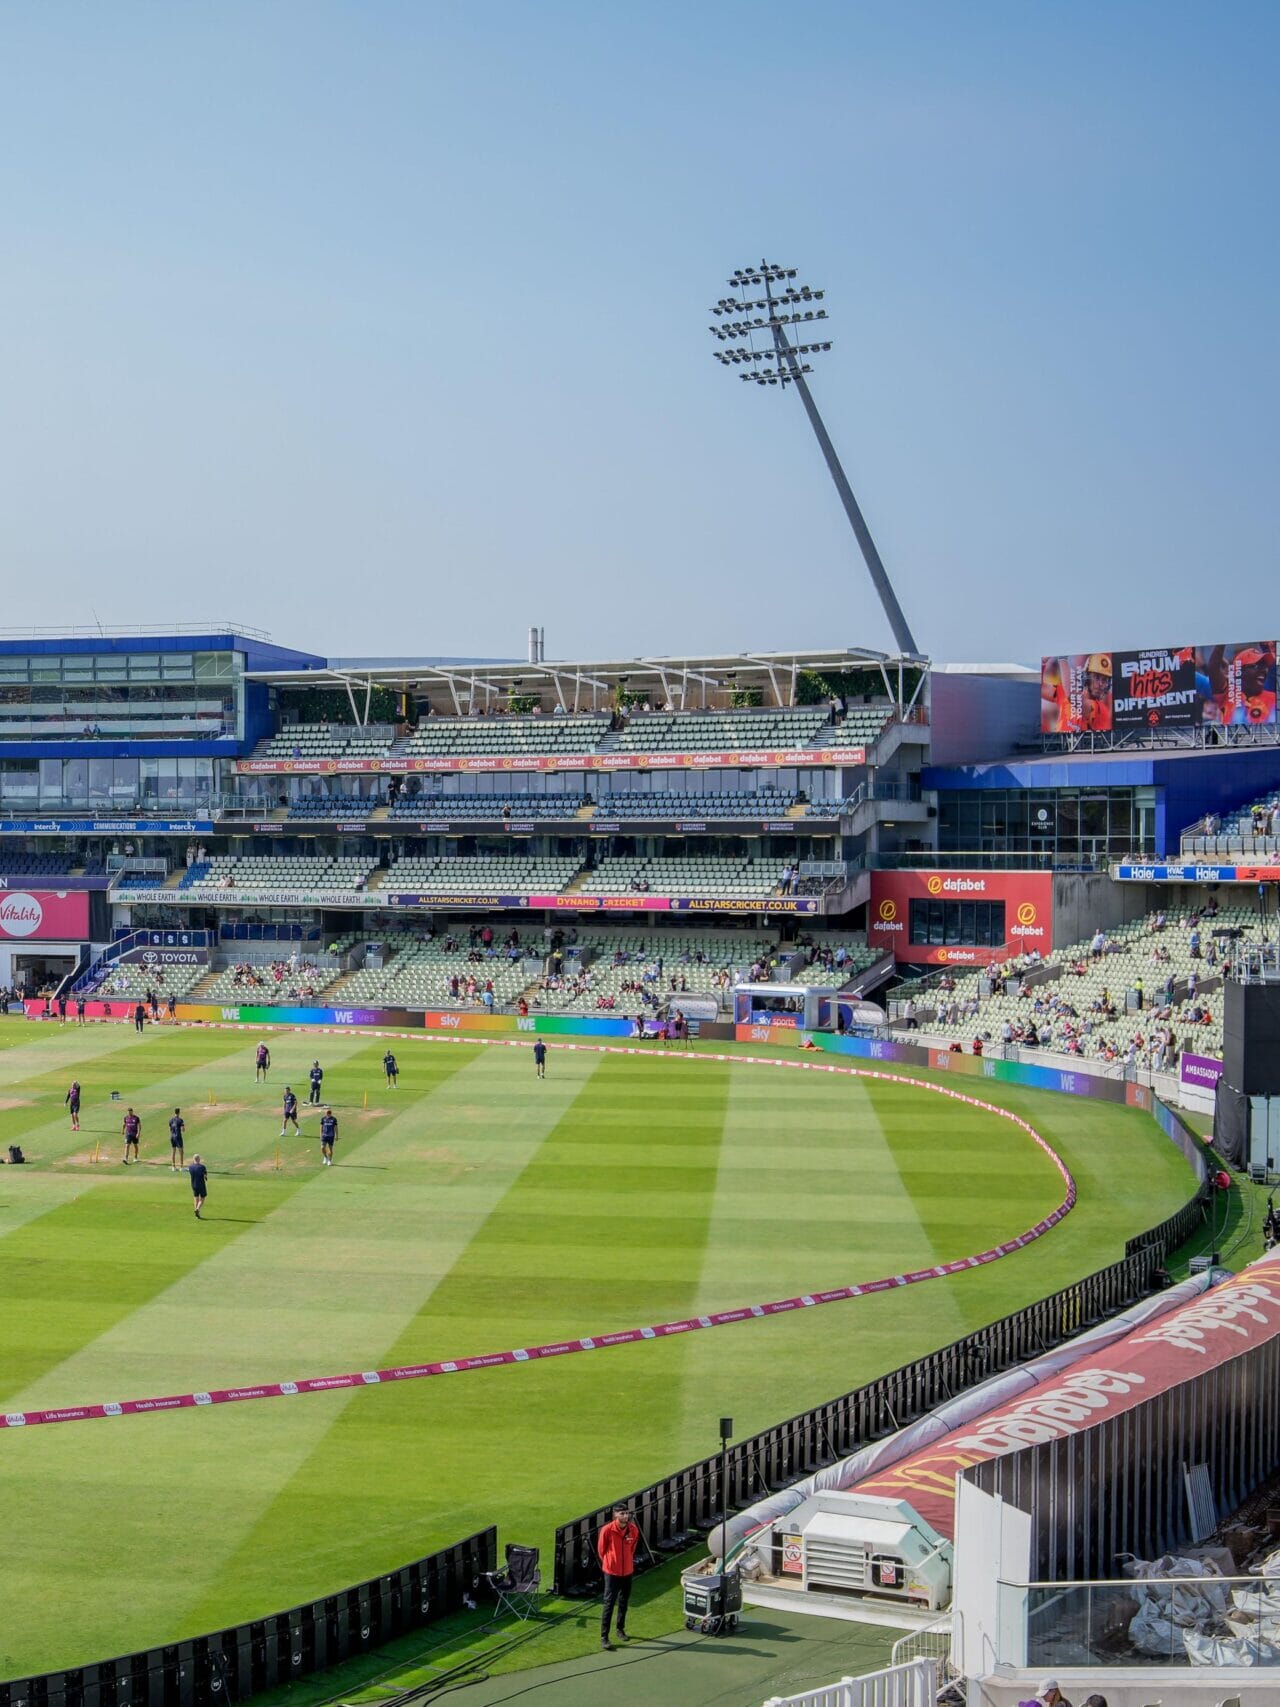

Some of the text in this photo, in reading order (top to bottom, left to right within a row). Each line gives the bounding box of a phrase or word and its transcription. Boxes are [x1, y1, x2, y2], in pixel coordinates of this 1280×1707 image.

[1121, 656, 1180, 677] BRUM
[1115, 690, 1196, 712] DIFFERENT
[649, 757, 676, 765] dafabet
[694, 755, 721, 764] dafabet
[740, 755, 767, 763] dafabet
[785, 754, 813, 762] dafabet
[832, 753, 861, 761] dafabet
[294, 762, 320, 770] dafabet
[337, 761, 363, 769] dafabet
[381, 761, 407, 769] dafabet
[424, 760, 451, 768] dafabet
[469, 759, 495, 767] dafabet
[513, 759, 539, 767] dafabet
[558, 758, 584, 766] dafabet
[603, 758, 630, 766] dafabet
[1131, 867, 1154, 879] Haier
[1196, 868, 1219, 880] Haier
[943, 879, 985, 892] dafabet
[156, 893, 175, 901] EARTH
[217, 894, 237, 902] EARTH
[320, 895, 360, 904] WHOLE EARTH
[418, 896, 499, 905] ALLSTARSCRICKET.CO.UK
[689, 901, 797, 910] ALLSTARSCRICKET.CO.UK
[0, 904, 41, 925] Vitality
[874, 922, 903, 931] dafabet
[1011, 926, 1043, 937] dafabet
[161, 954, 198, 962] TOYOTA
[948, 951, 974, 960] dafabet
[222, 1008, 240, 1020] WE
[335, 1012, 354, 1023] WE
[440, 1016, 460, 1028] sky
[517, 1018, 535, 1031] WE
[752, 1028, 770, 1040] sky
[871, 1043, 882, 1057] WE
[937, 1053, 949, 1069] sky
[983, 1062, 995, 1077] WE
[1185, 1064, 1218, 1080] AMBASSADOR
[1061, 1074, 1074, 1091] WE
